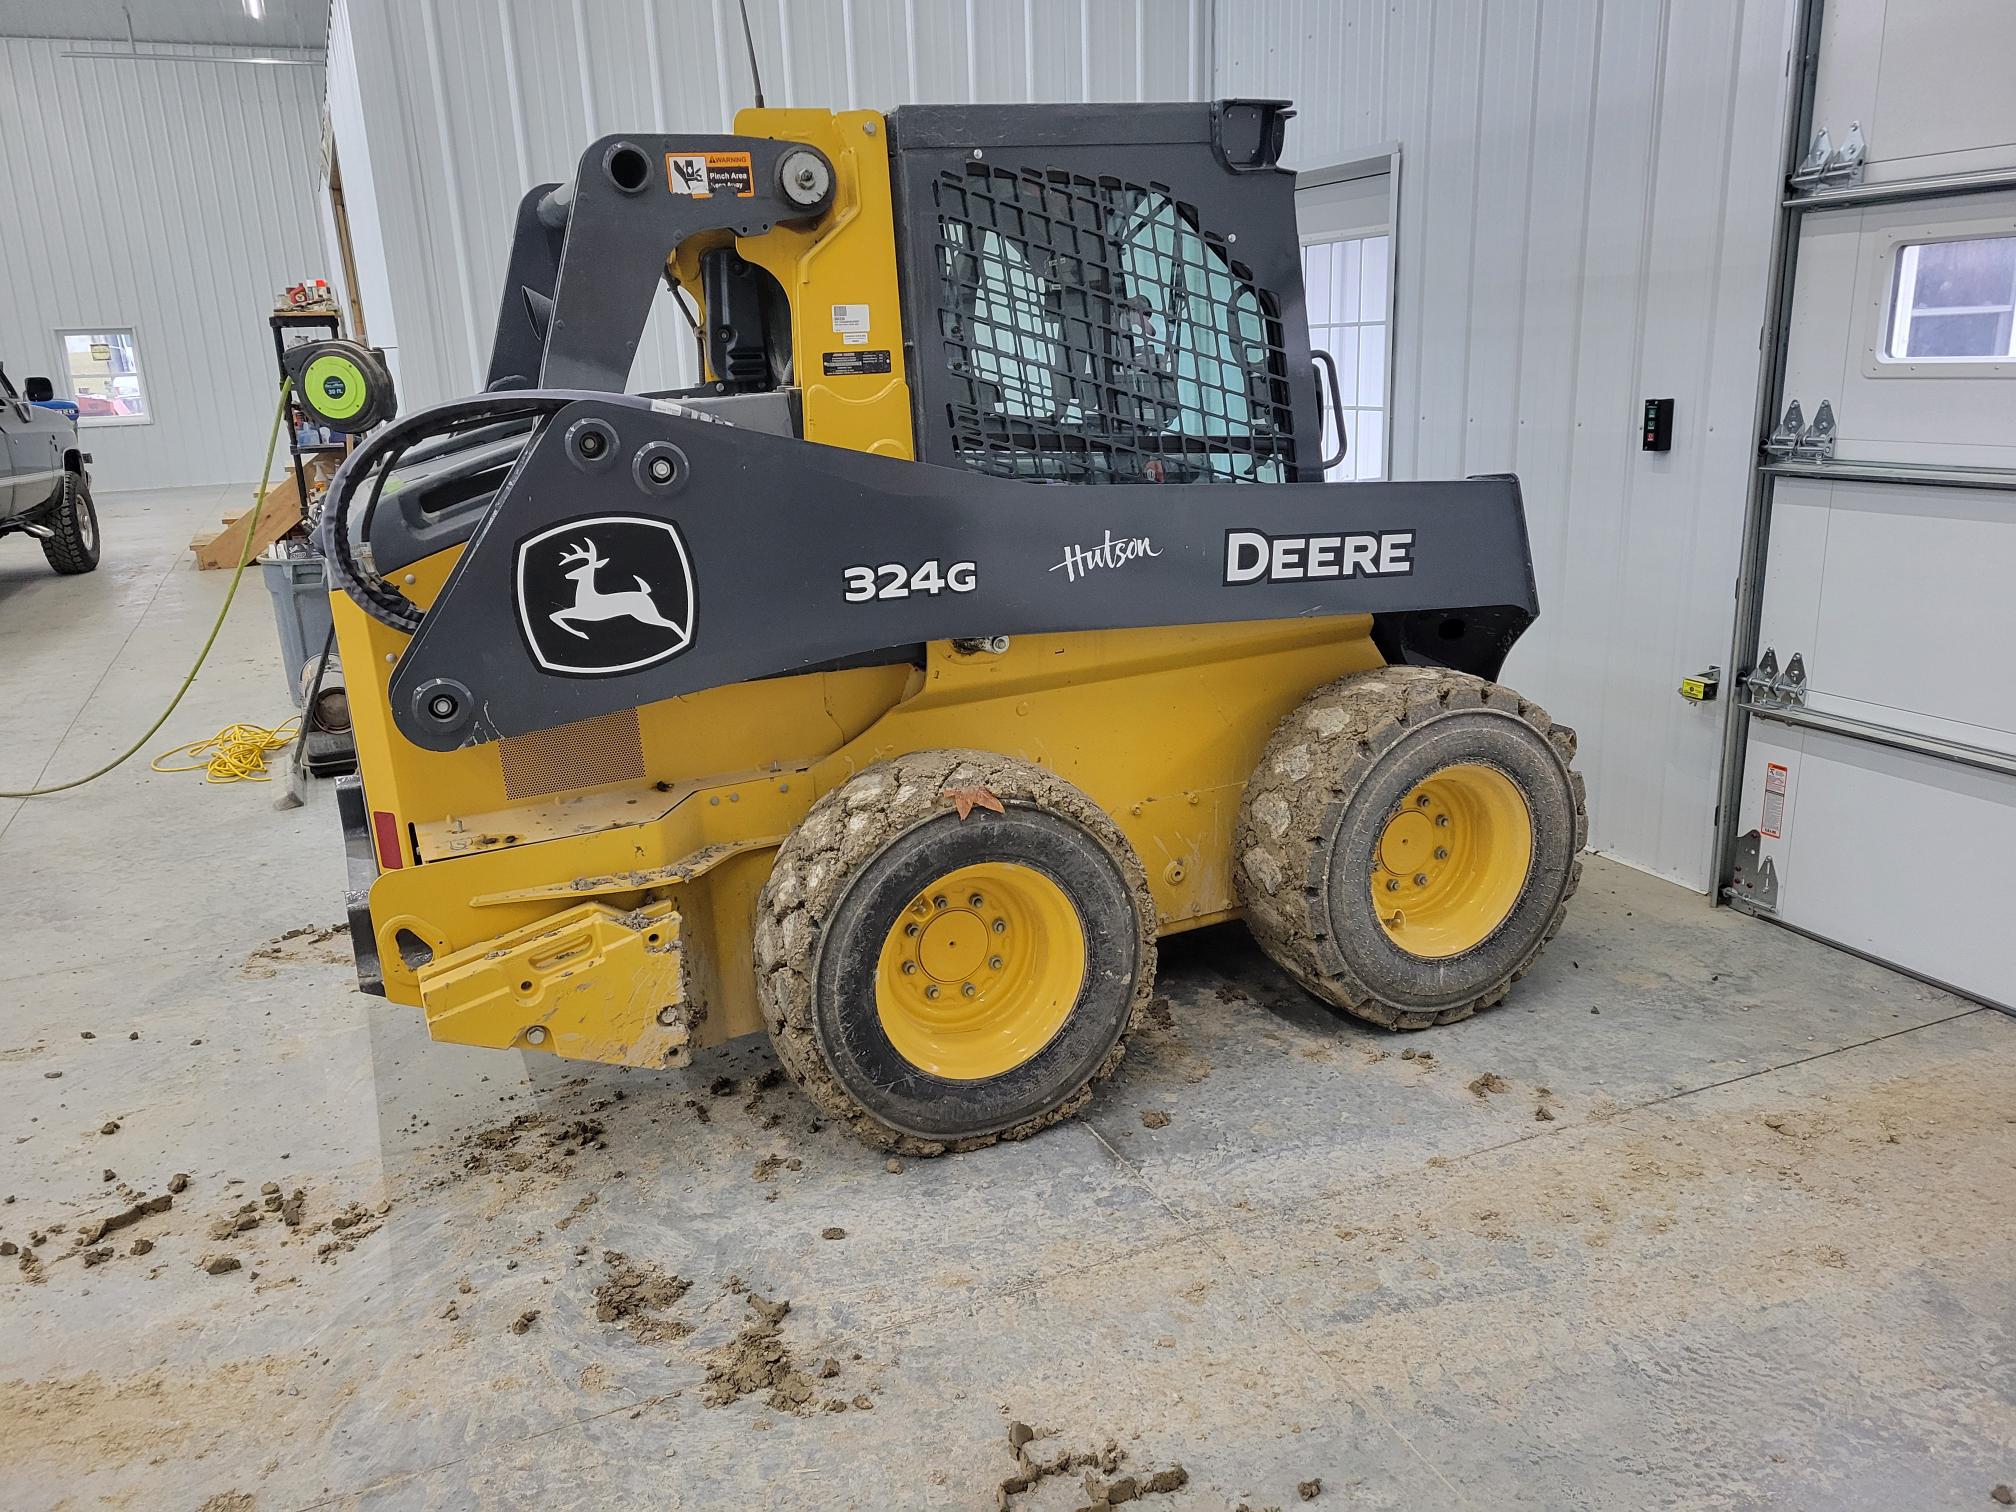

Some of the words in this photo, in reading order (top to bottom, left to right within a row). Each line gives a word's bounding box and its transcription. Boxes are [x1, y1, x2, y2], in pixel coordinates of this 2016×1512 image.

[709, 172, 729, 180] Pinch
[731, 172, 747, 180] Area
[1049, 530, 1164, 582] Hutson
[1227, 532, 1412, 582] DEERE
[844, 560, 976, 602] 324G
